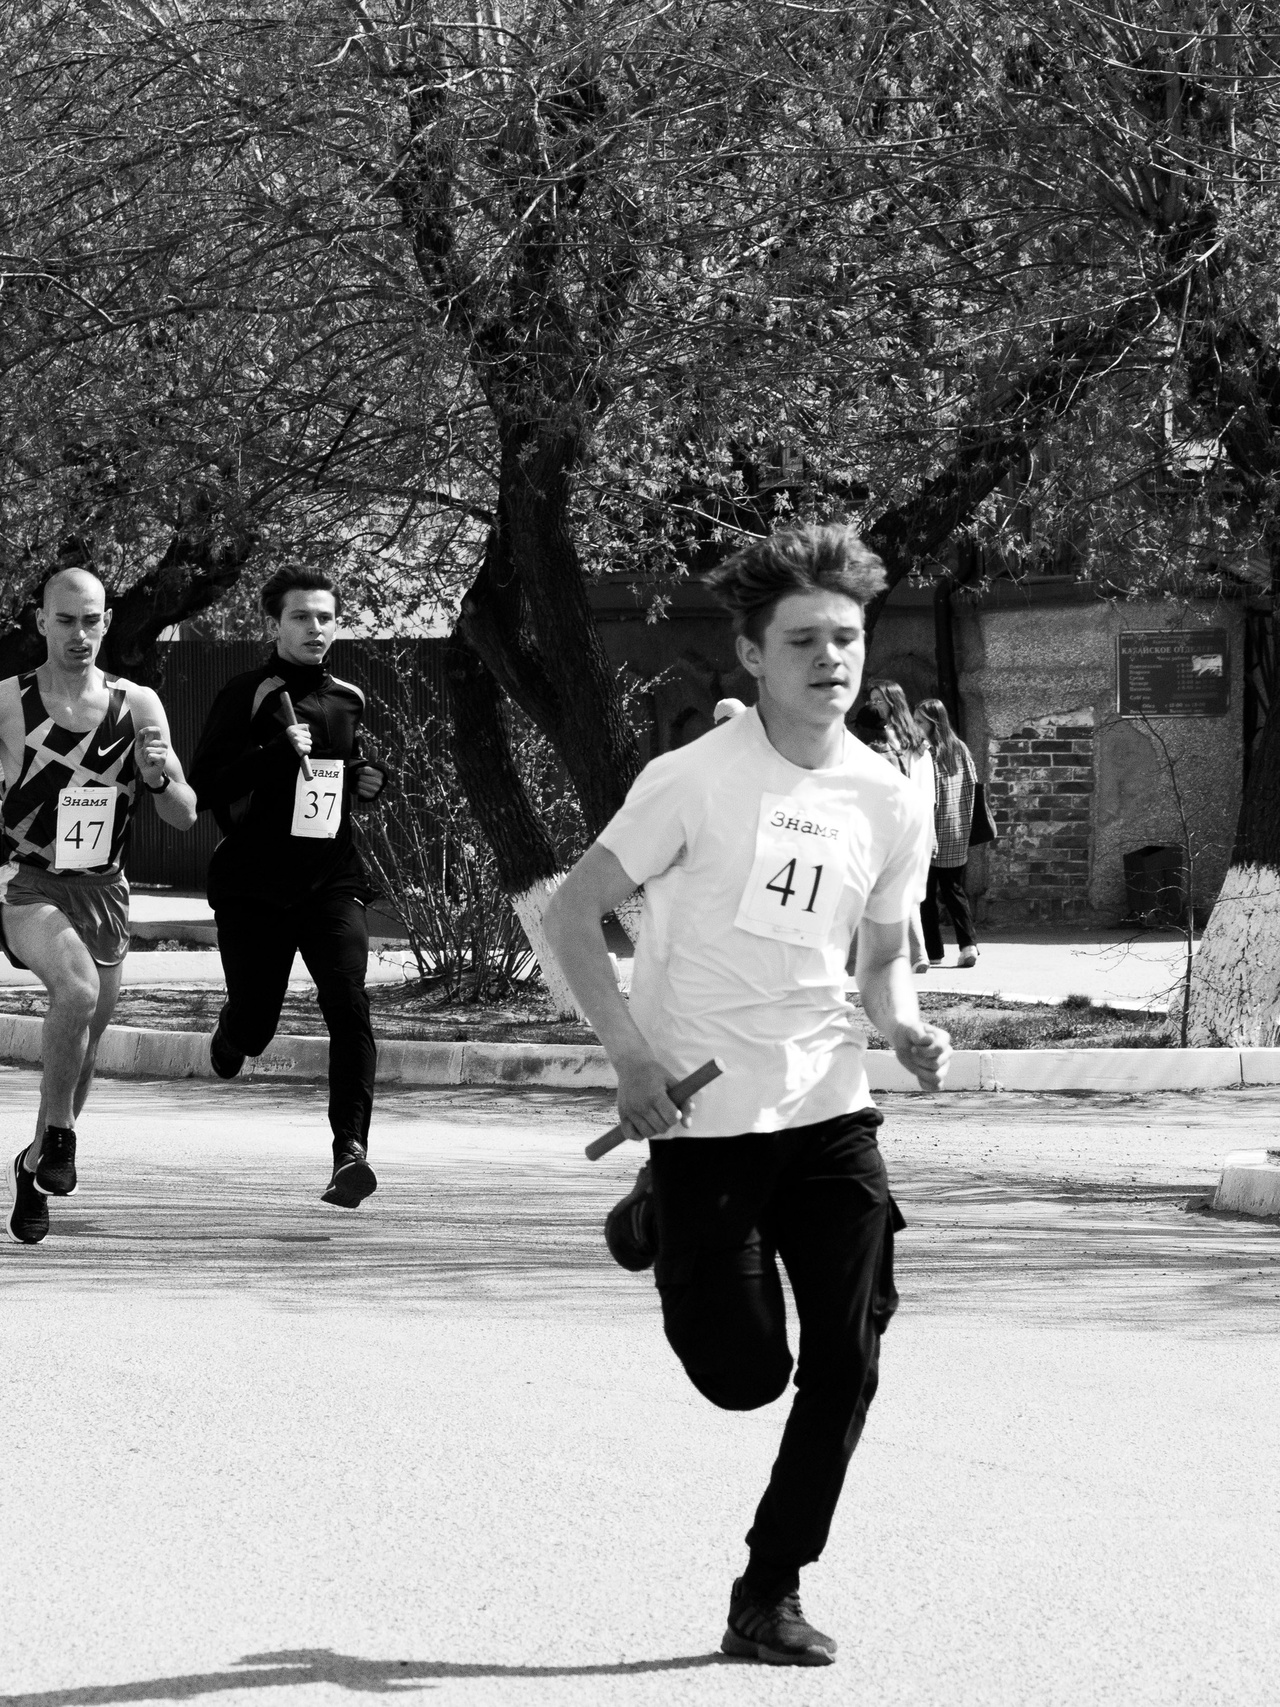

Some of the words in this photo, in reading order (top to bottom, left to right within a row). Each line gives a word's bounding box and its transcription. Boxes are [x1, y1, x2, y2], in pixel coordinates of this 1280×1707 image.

[311, 769, 340, 779] намя
[62, 796, 109, 806] Знамя
[304, 791, 337, 820] 37
[64, 820, 105, 850] 47
[770, 811, 840, 840] Знамя
[766, 858, 823, 914] 41
